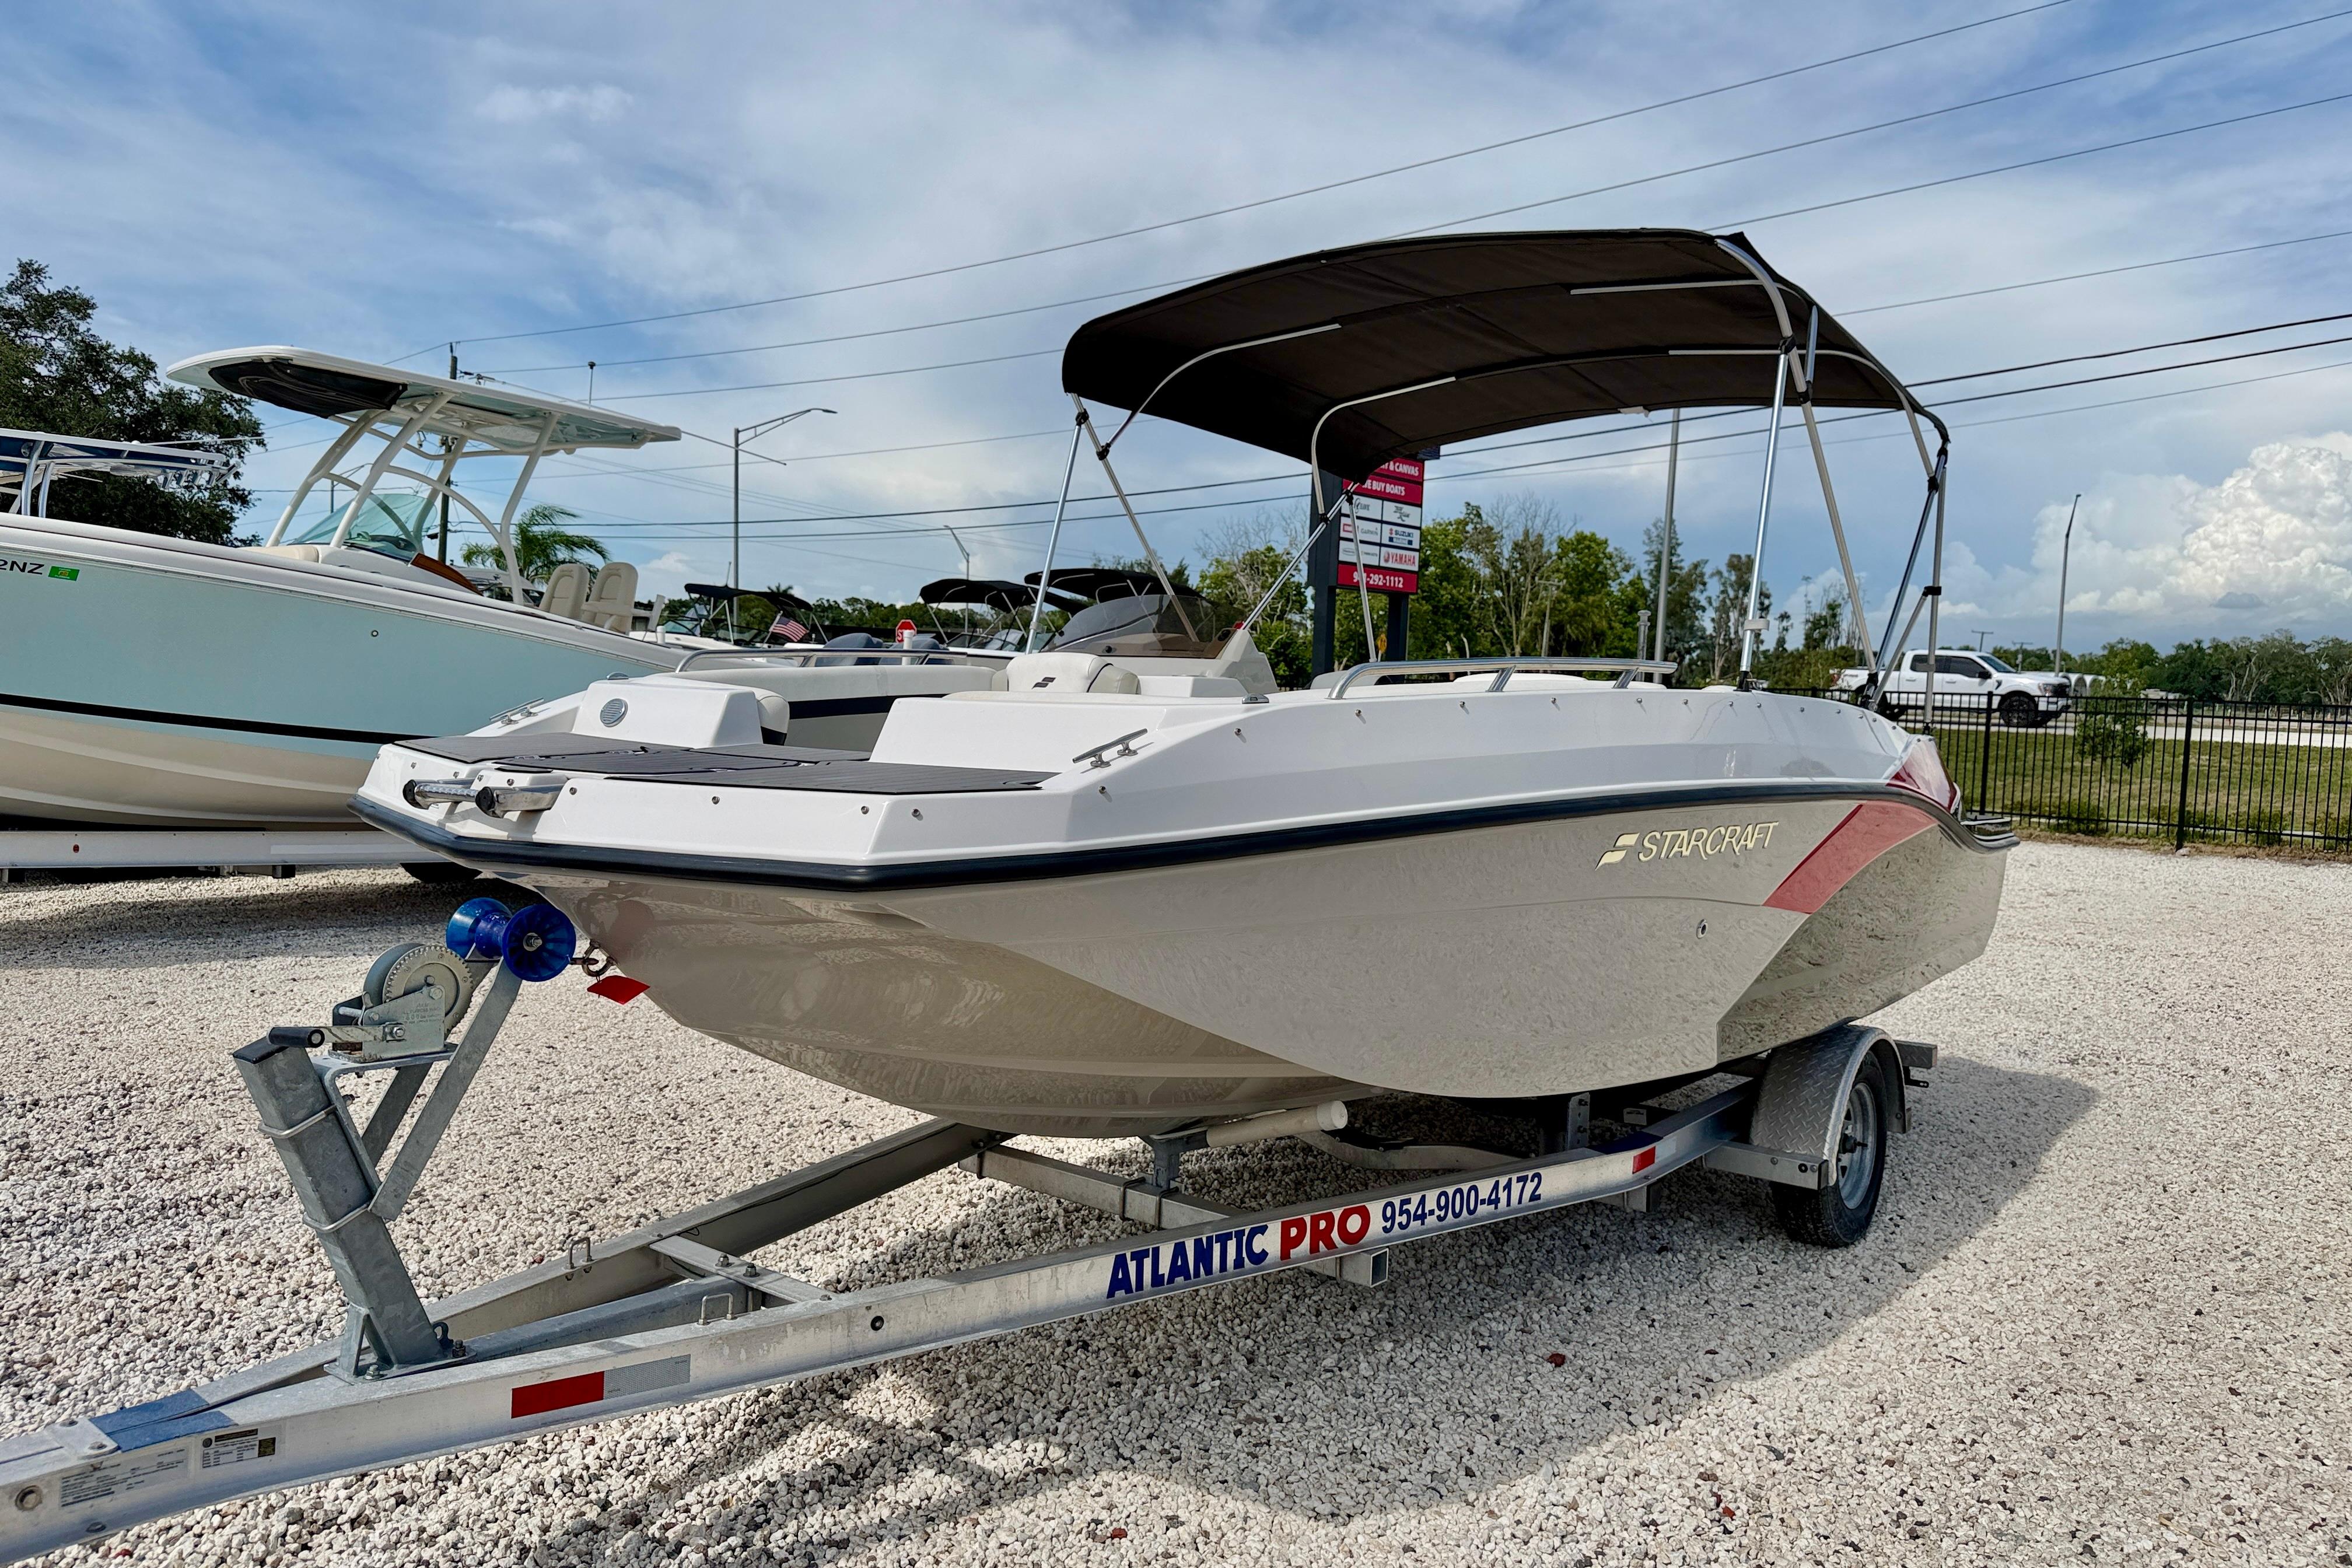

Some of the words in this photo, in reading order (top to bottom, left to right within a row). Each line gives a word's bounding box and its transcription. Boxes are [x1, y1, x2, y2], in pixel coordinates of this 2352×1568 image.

[1395, 463, 1419, 476] CANVAS
[1372, 481, 1385, 492] BUY
[1385, 484, 1405, 496] BOATS
[1395, 530, 1414, 538] SUZUKI
[1391, 552, 1416, 566] YAMAHA
[1638, 821, 1779, 862] STARCRAFT
[1107, 1224, 1268, 1298] ATLANTIC
[1280, 1205, 1370, 1261] PRO
[1382, 1172, 1542, 1234] 954-900-4172
